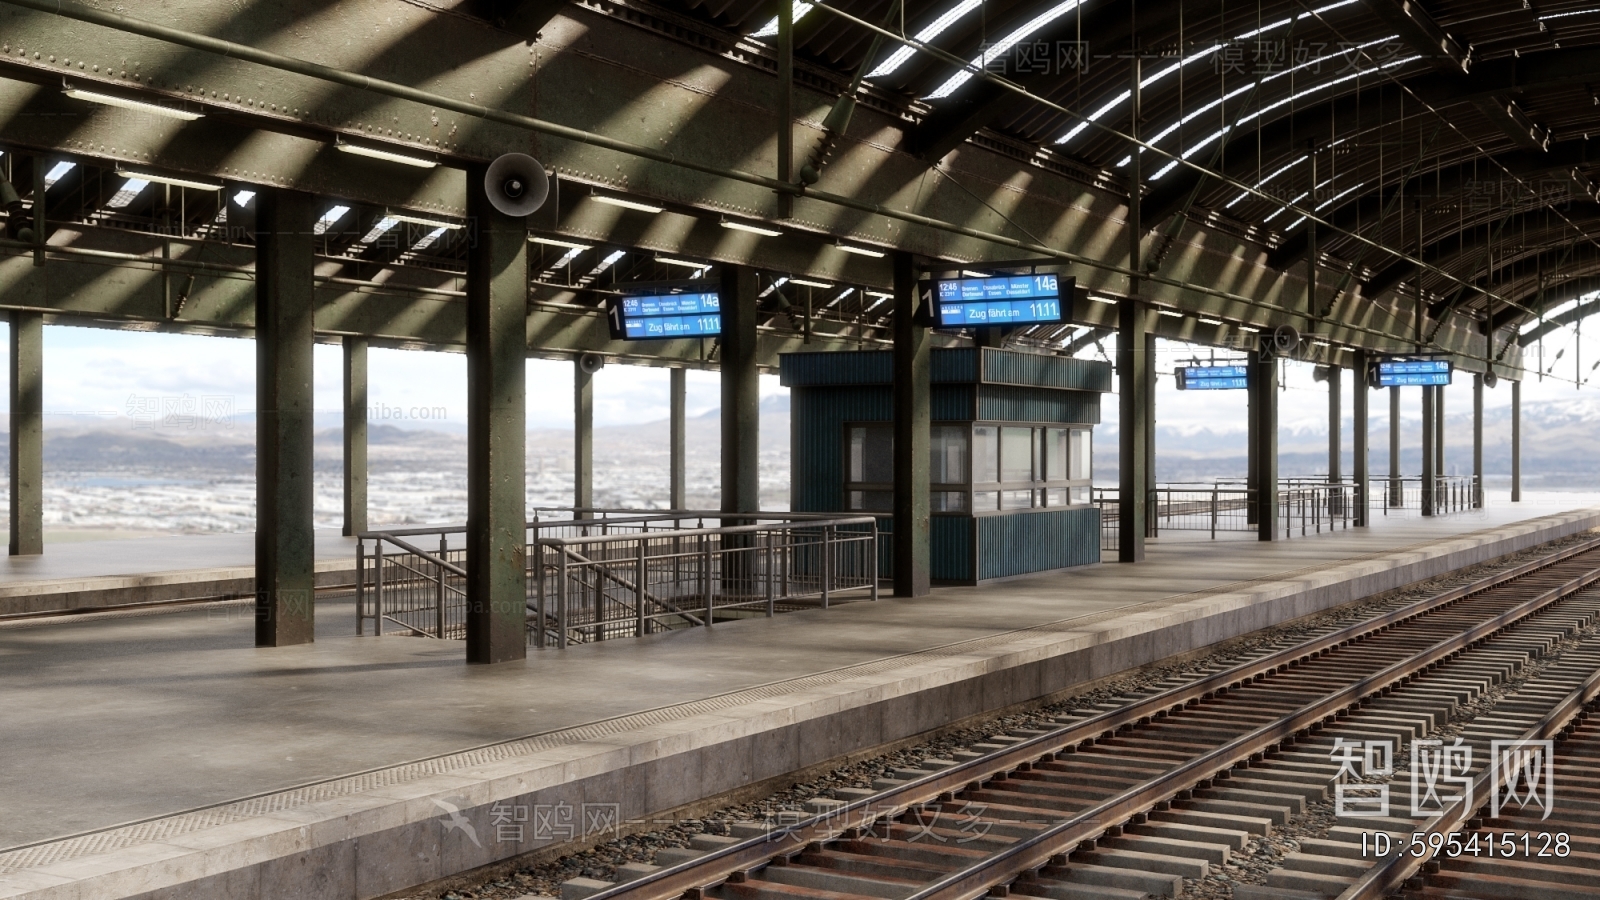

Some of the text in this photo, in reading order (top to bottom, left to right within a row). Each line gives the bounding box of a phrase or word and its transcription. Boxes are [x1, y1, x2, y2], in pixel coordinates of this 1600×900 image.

[1035, 276, 1058, 291] 14a
[701, 294, 719, 308] 14a
[922, 289, 935, 318] 1
[969, 309, 986, 319] Zug
[988, 308, 1007, 317] fährt
[1030, 302, 1059, 318] 11.11.
[609, 305, 620, 330] 1
[697, 317, 721, 331] 11.11.
[649, 323, 663, 333] Zug
[664, 322, 679, 331] fährt
[1435, 362, 1449, 370] 14a
[1369, 367, 1377, 382] 1
